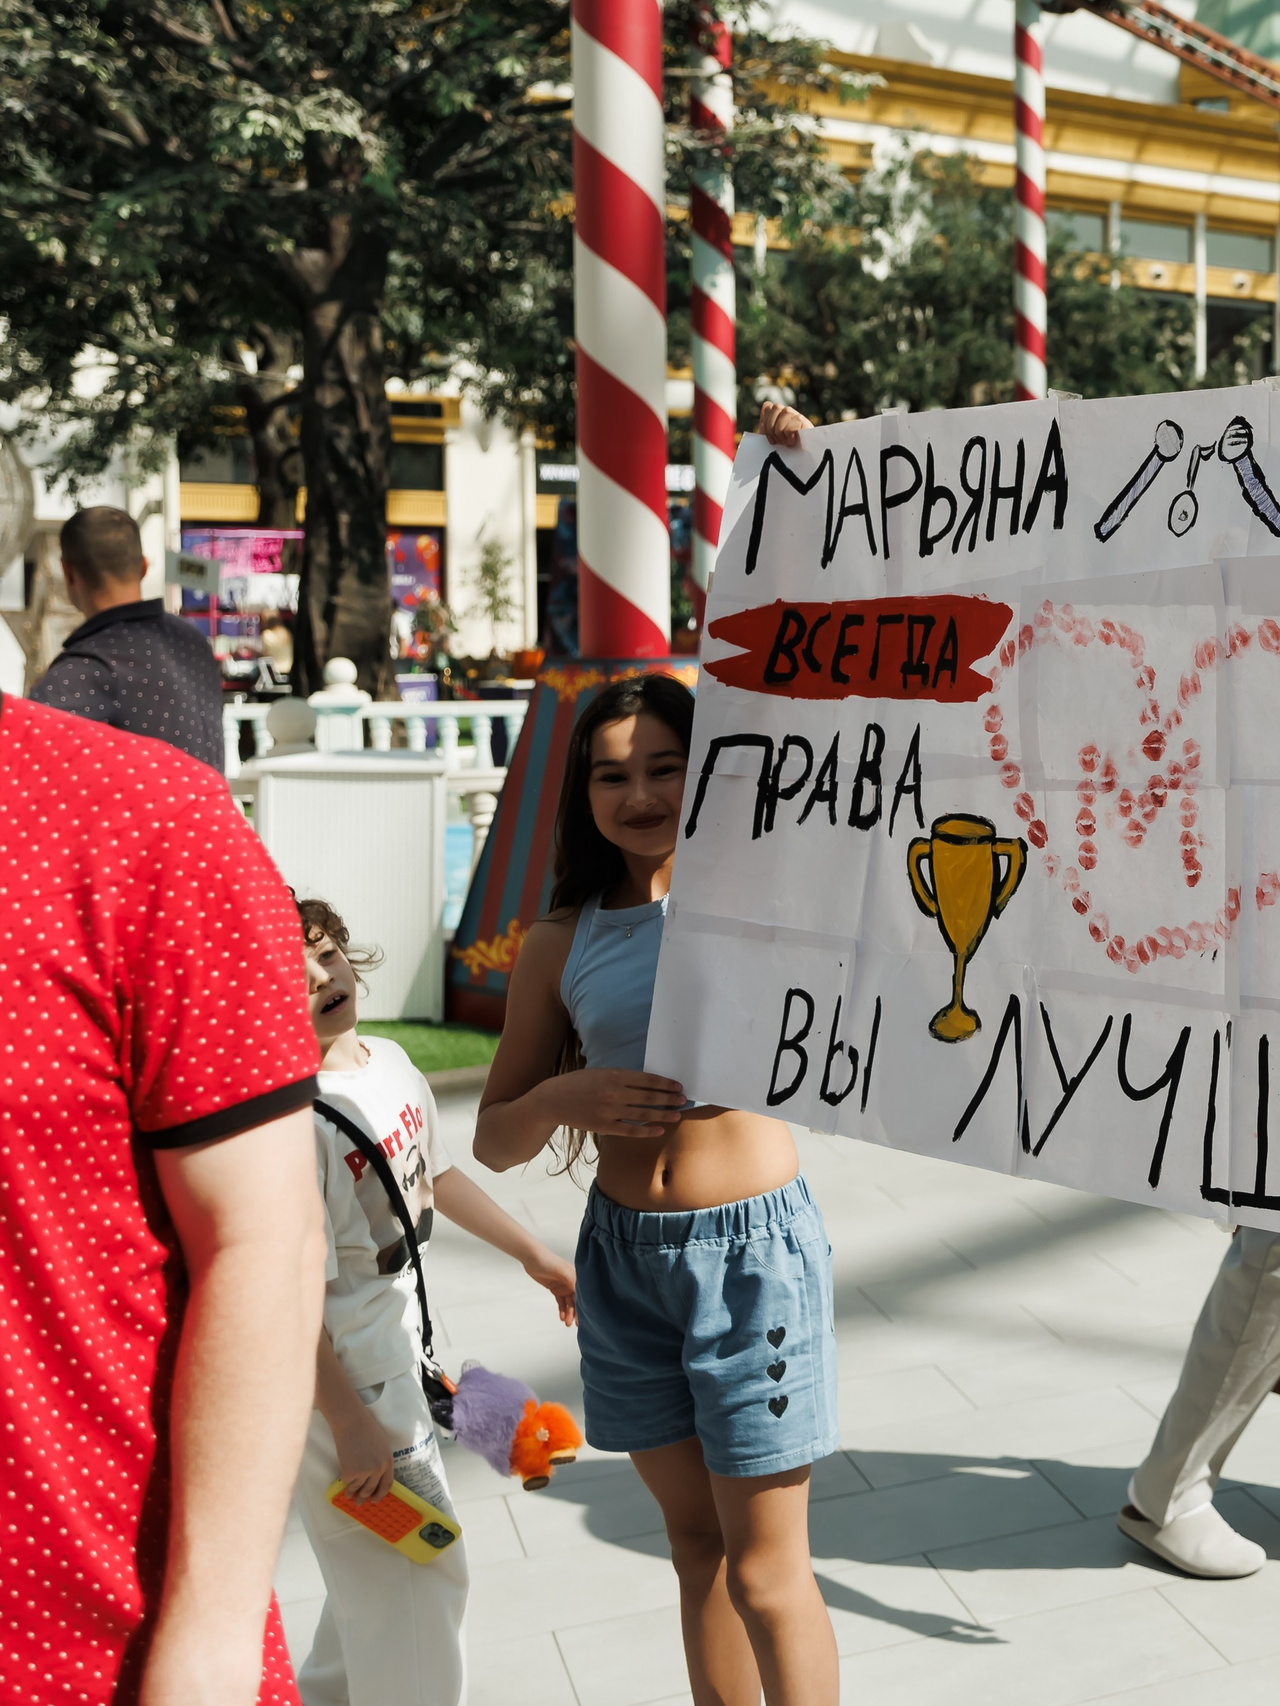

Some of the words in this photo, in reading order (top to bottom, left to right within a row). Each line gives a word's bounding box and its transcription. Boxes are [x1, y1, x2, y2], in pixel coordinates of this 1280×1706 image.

[745, 416, 1069, 575] МАРЬЯНА
[763, 608, 959, 688] ВСЕГДА
[685, 722, 925, 840] ПРАВА
[766, 987, 881, 1114] ВЫ
[399, 1103, 423, 1140] Flo
